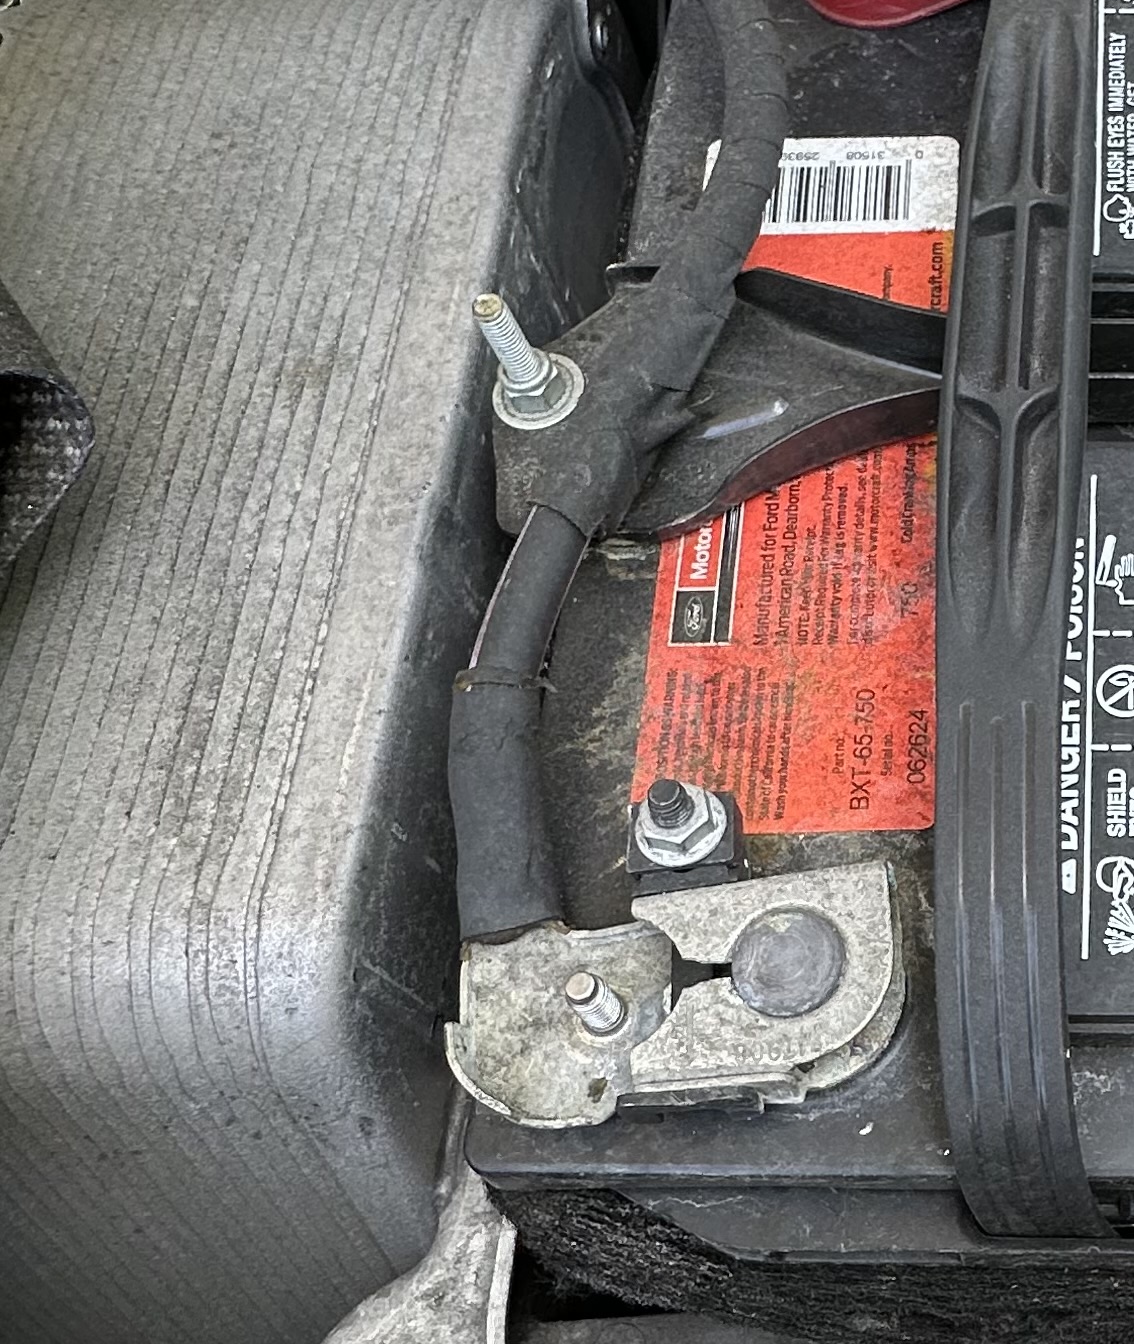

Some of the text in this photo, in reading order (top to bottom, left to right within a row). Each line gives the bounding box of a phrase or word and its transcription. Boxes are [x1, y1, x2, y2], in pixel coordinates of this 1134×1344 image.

[1106, 33, 1126, 192] FLUSH EYES IMMEDIATELY
[857, 476, 866, 491] see
[902, 472, 915, 518] Cranking
[762, 504, 779, 531] Ford
[783, 481, 801, 540] Dearborn,
[836, 483, 848, 529] removed.
[819, 503, 833, 545] Warranty
[835, 531, 845, 541] is
[901, 519, 914, 543] Cold
[690, 520, 712, 580] Motor
[761, 534, 776, 551] for
[818, 547, 829, 561] For
[780, 542, 797, 576] Road,
[830, 562, 843, 570] if
[814, 563, 829, 606] Required
[830, 573, 842, 594] void
[753, 554, 775, 646] Manufactured
[775, 576, 793, 638] American
[901, 582, 919, 617] 750
[686, 604, 700, 630] Ford
[812, 609, 825, 645] Receipt
[827, 596, 842, 647] Warranty
[782, 723, 791, 745] after
[849, 688, 875, 810] BXT-65-750
[907, 709, 928, 784] 062624
[761, 745, 774, 786] California
[777, 746, 790, 774] hands
[832, 752, 844, 774] Part
[881, 749, 893, 776] Serial
[760, 787, 772, 796] of
[777, 775, 788, 794] your
[759, 797, 770, 820] State
[773, 795, 784, 821] Wash
[1107, 768, 1126, 838] SHIELD
